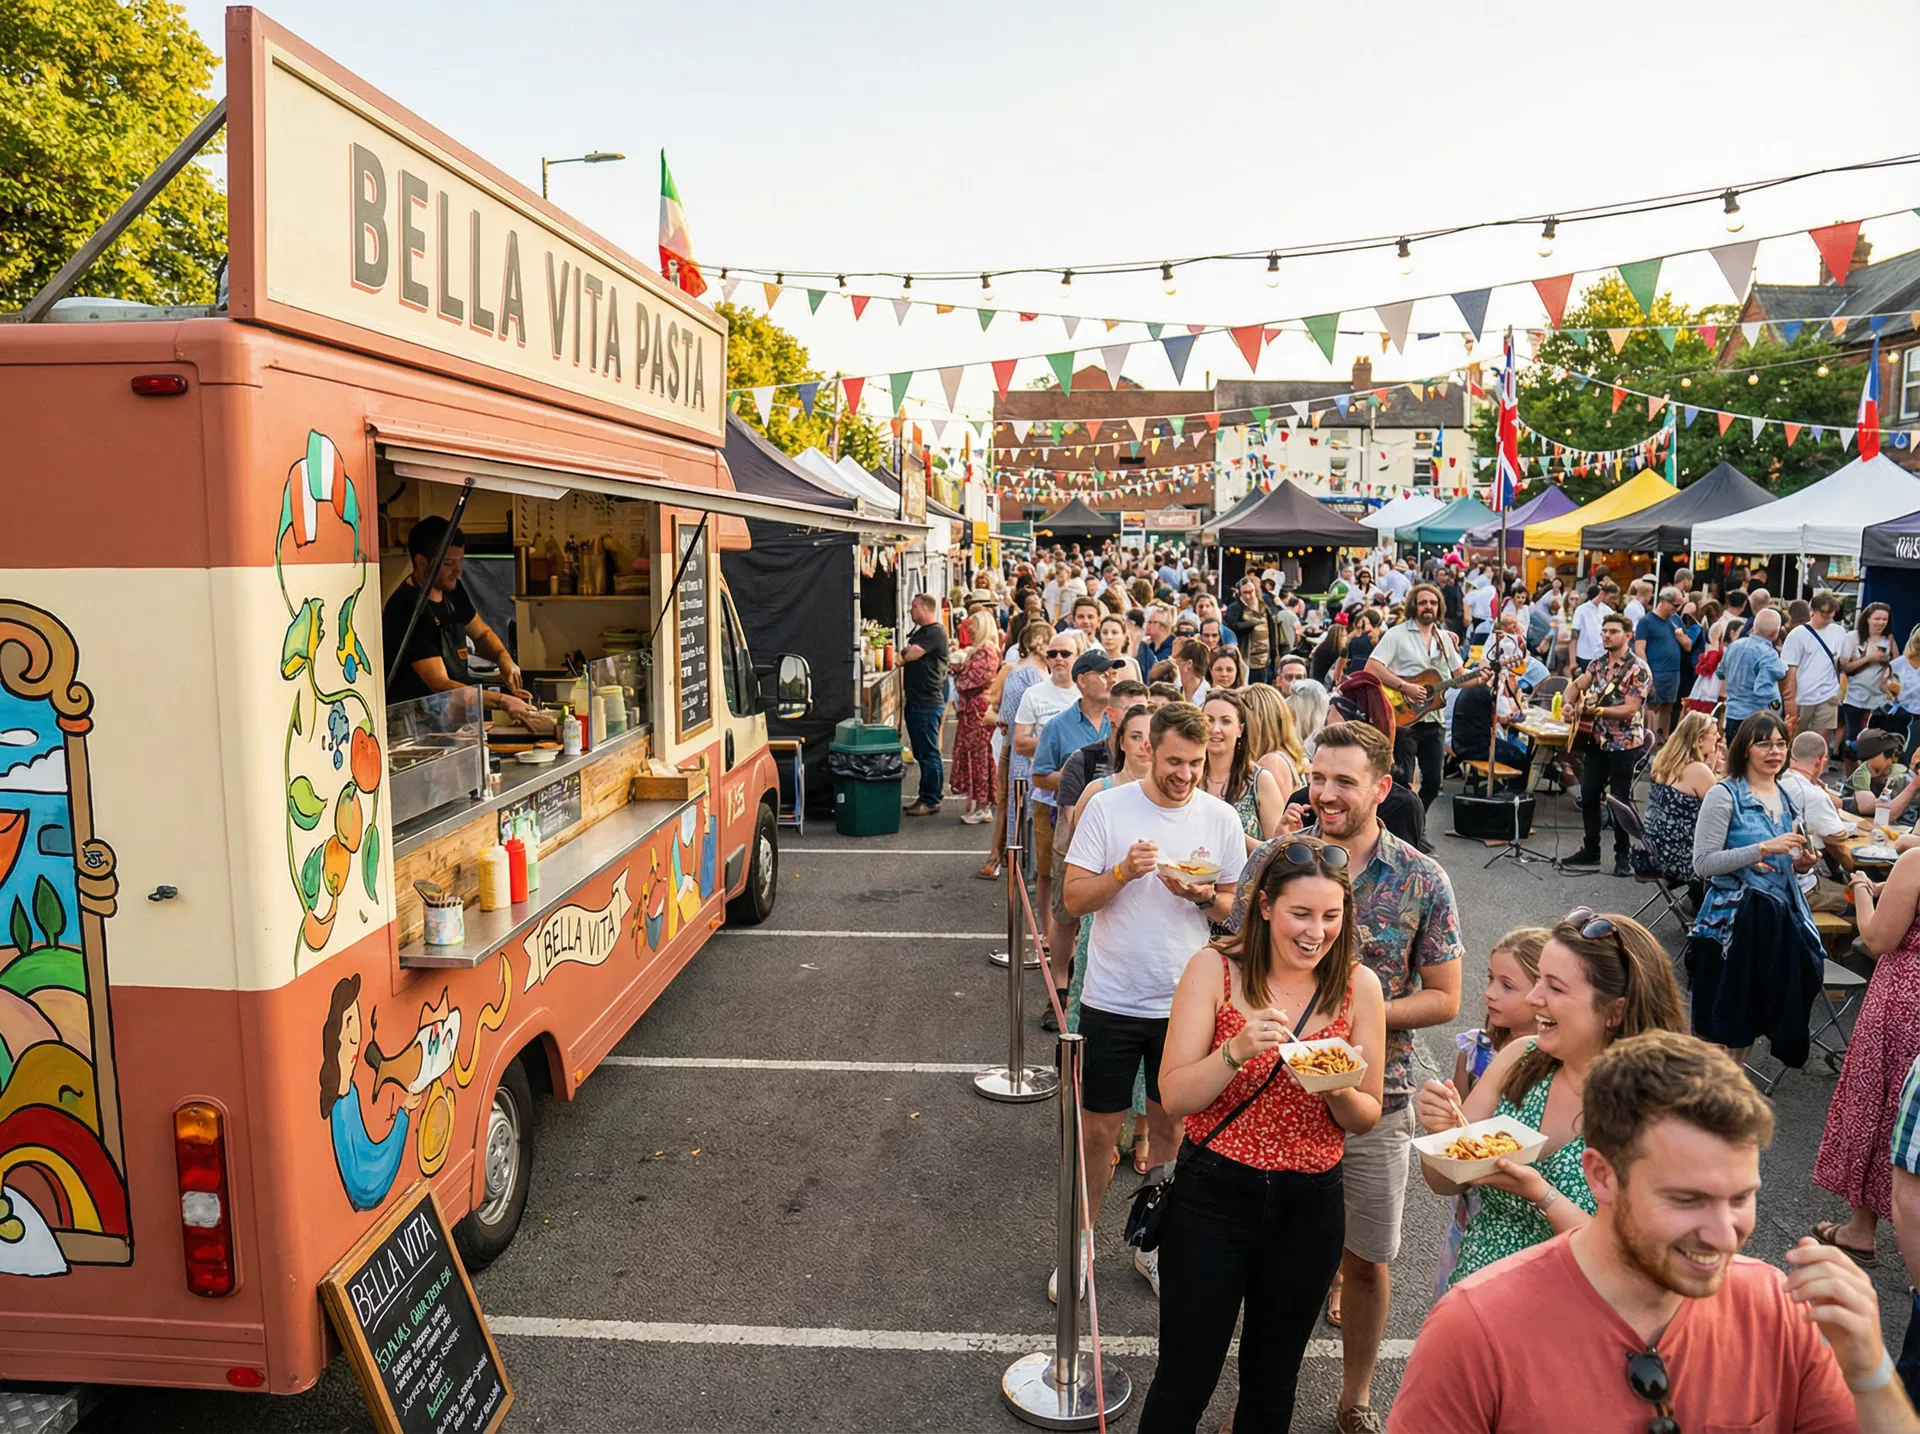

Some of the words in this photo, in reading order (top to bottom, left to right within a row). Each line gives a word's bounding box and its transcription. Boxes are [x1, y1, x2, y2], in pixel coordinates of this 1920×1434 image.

[349, 142, 526, 348] BELLA
[545, 251, 622, 383] VITA
[635, 301, 706, 412] PASTA
[544, 916, 583, 968] BELLA
[588, 910, 616, 956] VITA
[350, 1248, 405, 1328] BELLA
[397, 1212, 437, 1267] VITA
